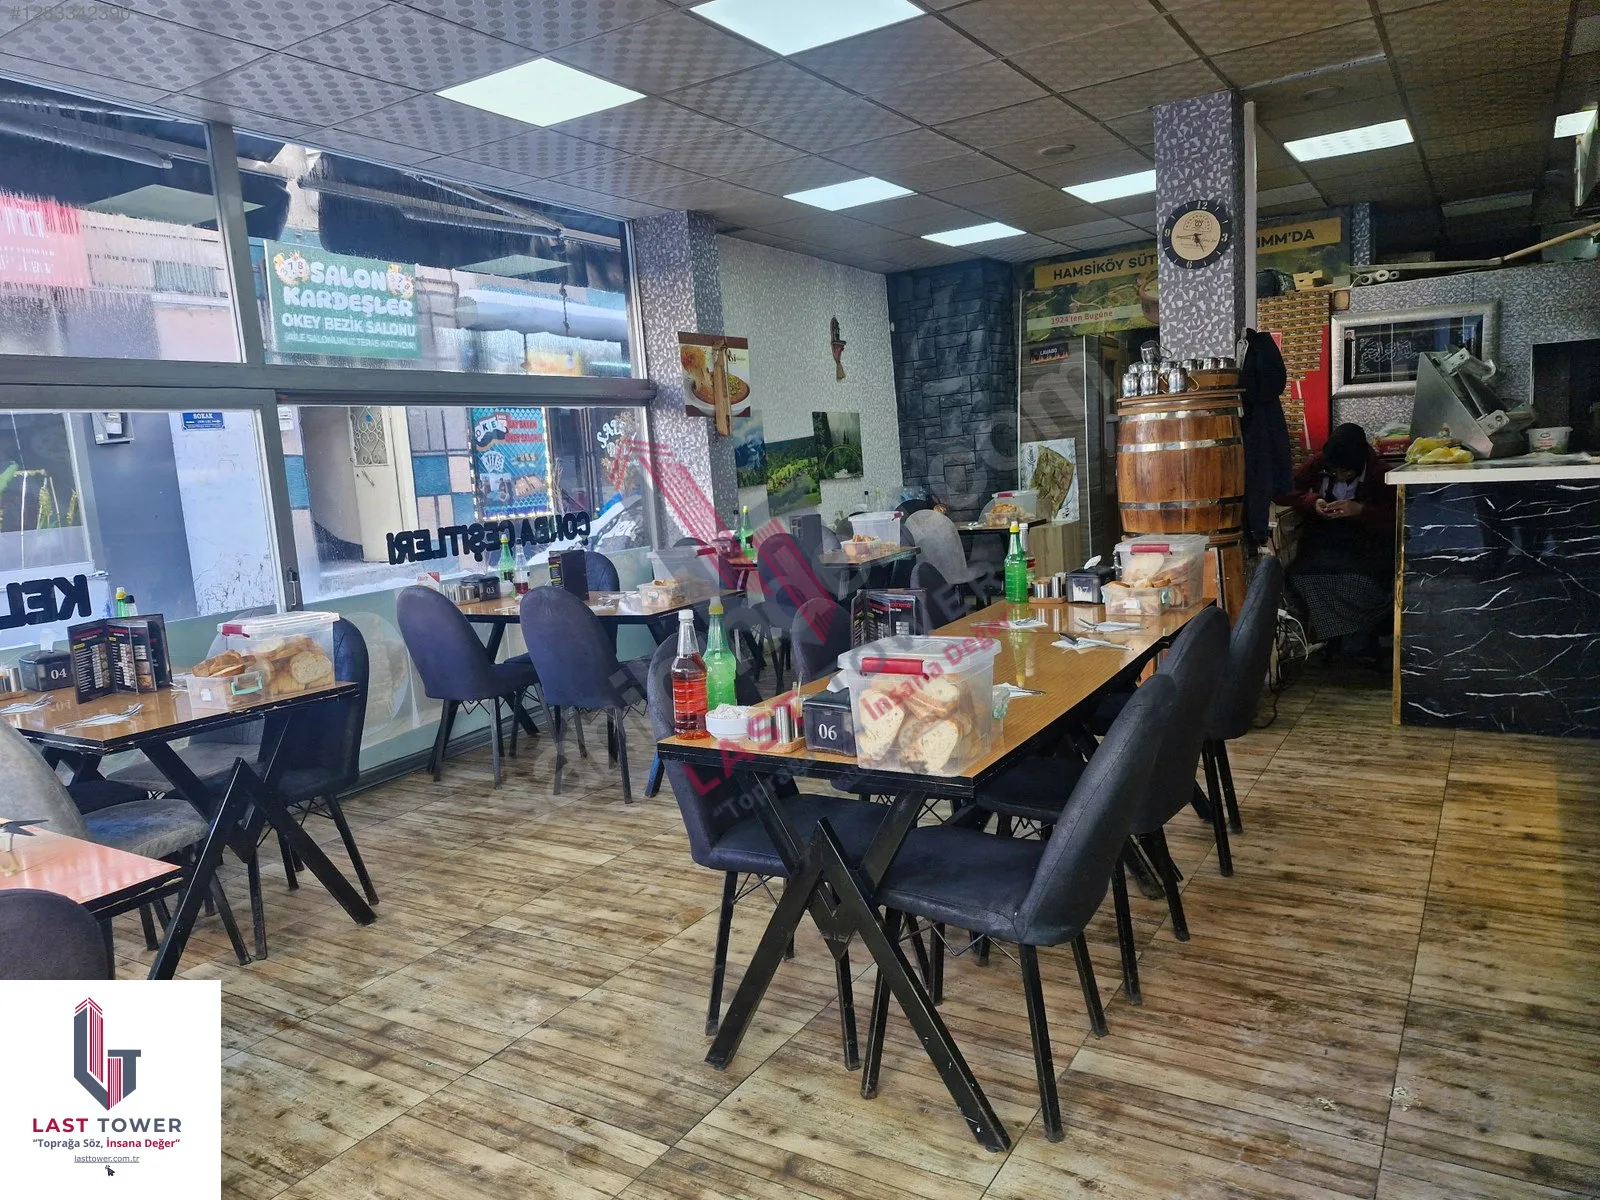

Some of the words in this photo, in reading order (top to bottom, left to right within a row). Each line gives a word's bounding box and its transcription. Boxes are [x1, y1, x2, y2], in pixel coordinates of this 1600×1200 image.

[310, 261, 387, 291] SALON
[1053, 258, 1124, 281] HAMSİKÖY
[1128, 253, 1158, 269] SÜT
[283, 286, 413, 317] KARDEŞLER
[282, 313, 320, 329] OKEY
[325, 315, 364, 333] BEZİK
[364, 320, 416, 337] SALONU
[1085, 310, 1113, 321] Bugüne
[1040, 347, 1058, 356] LAVABO
[50, 667, 68, 680] 04
[818, 723, 838, 741] 06
